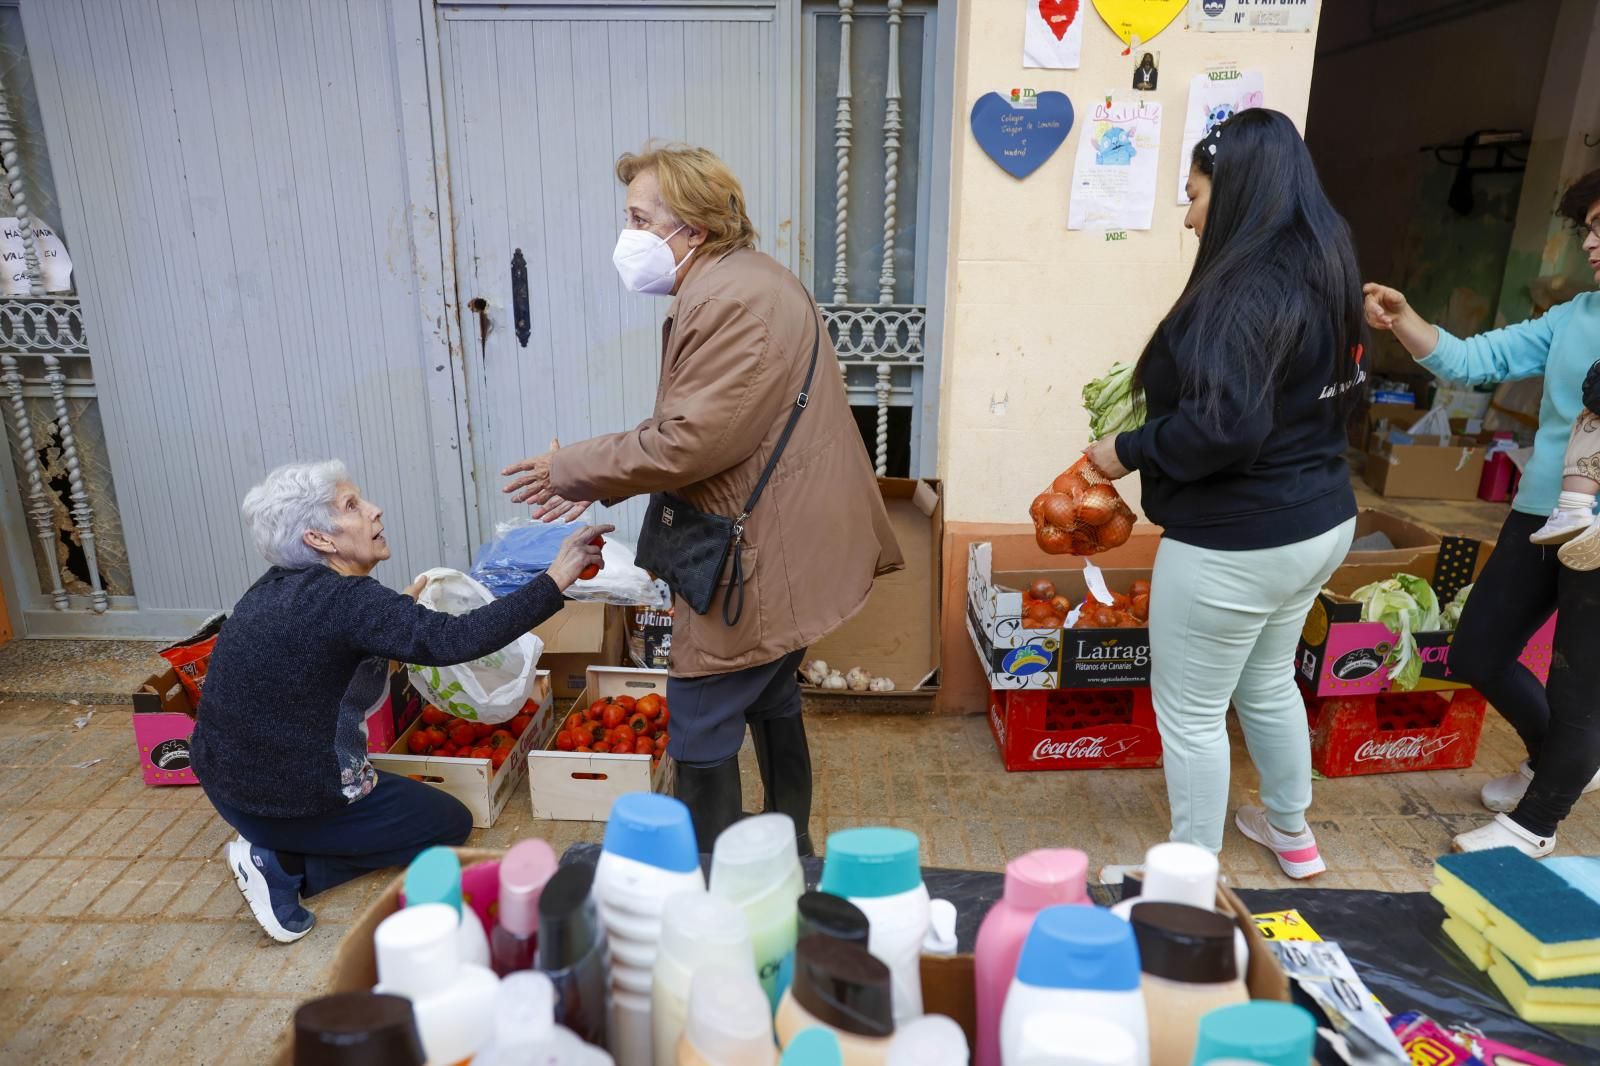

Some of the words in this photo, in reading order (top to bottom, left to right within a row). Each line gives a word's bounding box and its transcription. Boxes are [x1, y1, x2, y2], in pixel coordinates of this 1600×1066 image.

[635, 611, 672, 627] ultim
[1076, 640, 1152, 666] Lairag
[1100, 662, 1108, 670] de
[1108, 662, 1132, 670] Canarias
[1032, 736, 1107, 760] Coca-Cola
[1354, 735, 1424, 762] Coca-Cola
